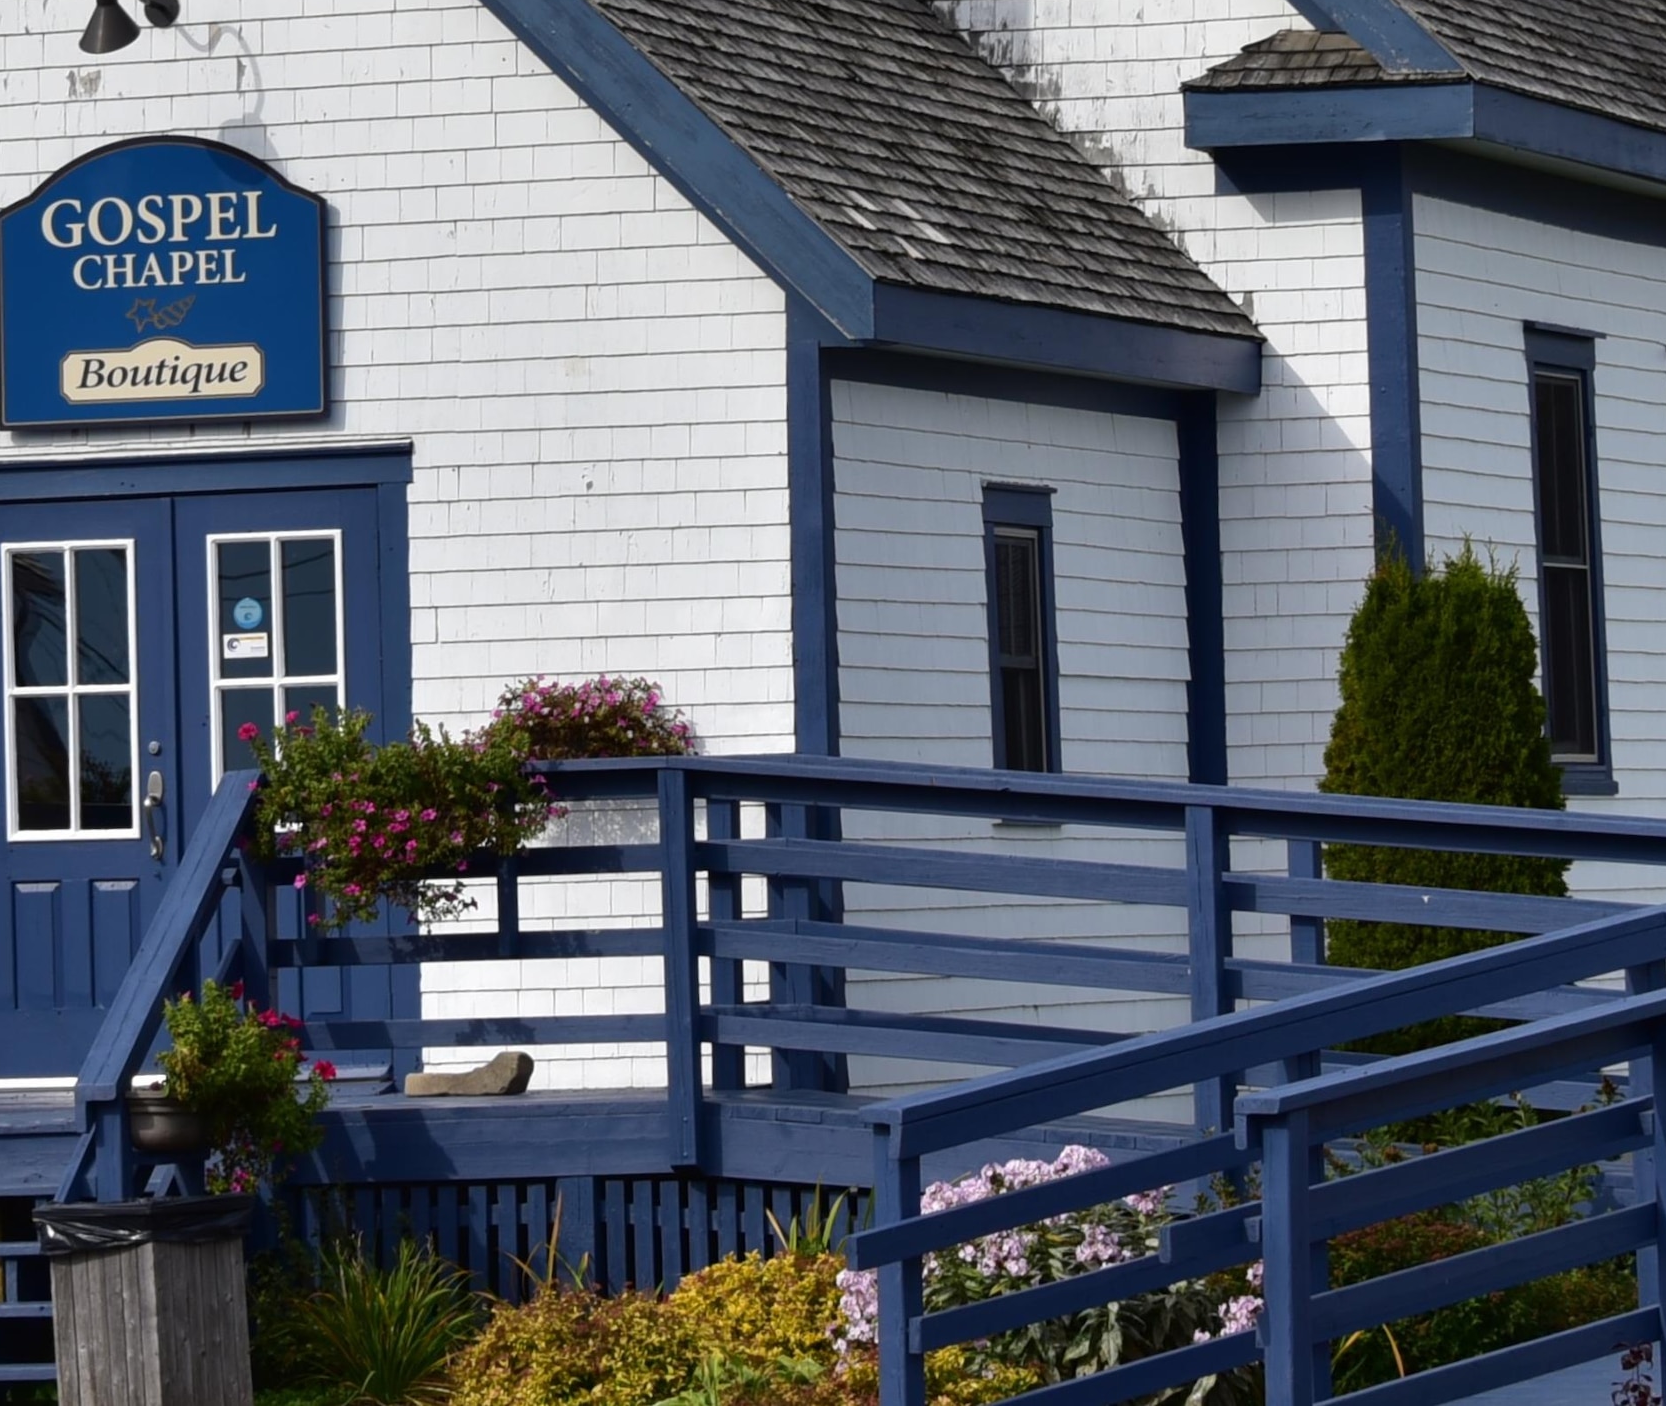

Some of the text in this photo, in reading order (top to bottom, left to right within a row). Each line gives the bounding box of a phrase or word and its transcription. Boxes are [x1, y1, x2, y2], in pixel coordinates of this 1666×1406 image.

[41, 190, 277, 248] GOSPEL
[72, 249, 246, 290] CHAPEL
[76, 355, 249, 394] Boutique
